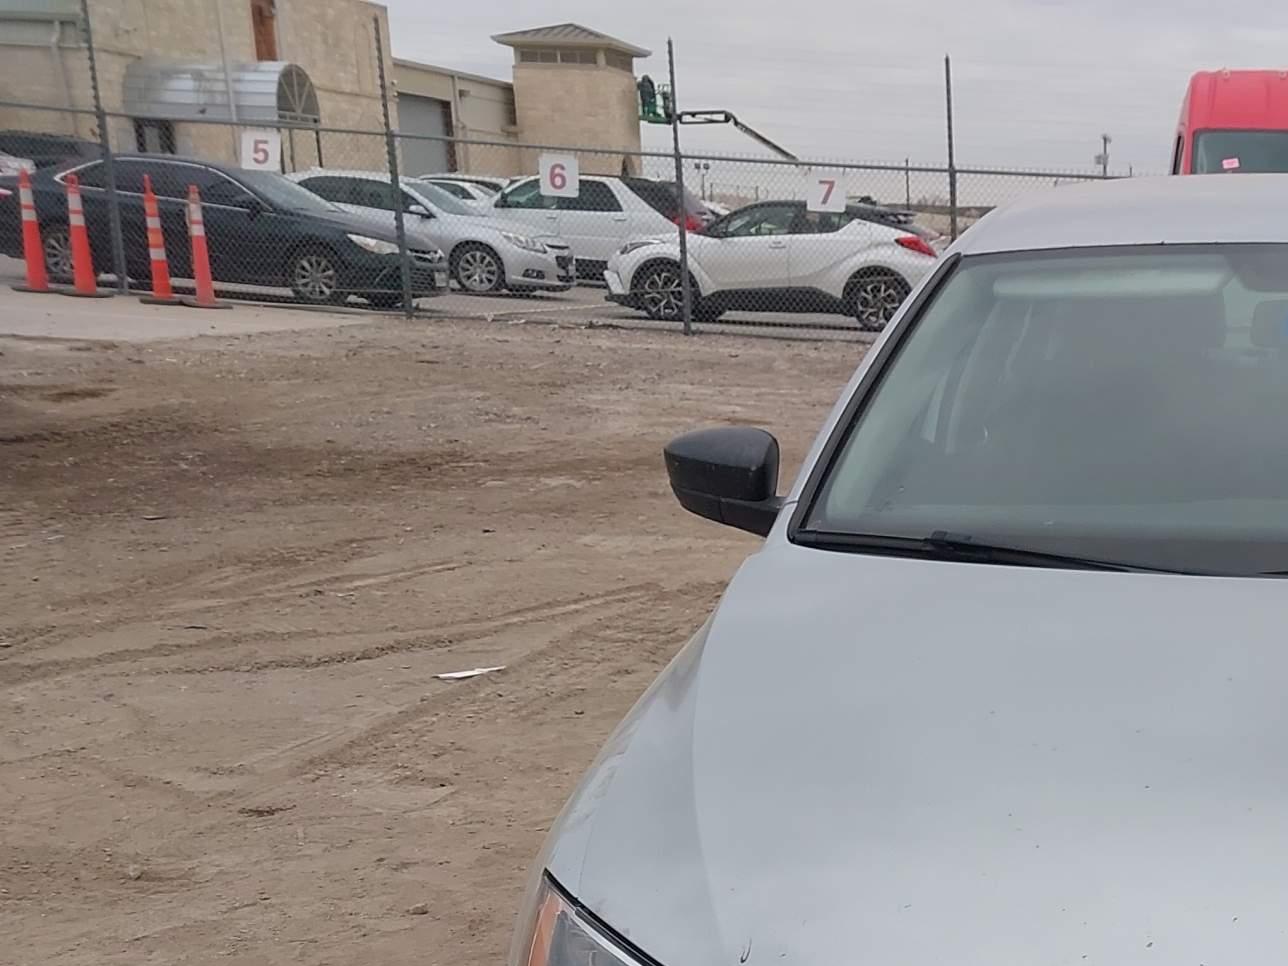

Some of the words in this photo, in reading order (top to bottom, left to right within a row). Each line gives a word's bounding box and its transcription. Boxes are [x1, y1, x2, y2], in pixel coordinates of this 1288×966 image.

[252, 139, 269, 165] 5
[549, 162, 567, 190] 6
[818, 180, 836, 205] 7
